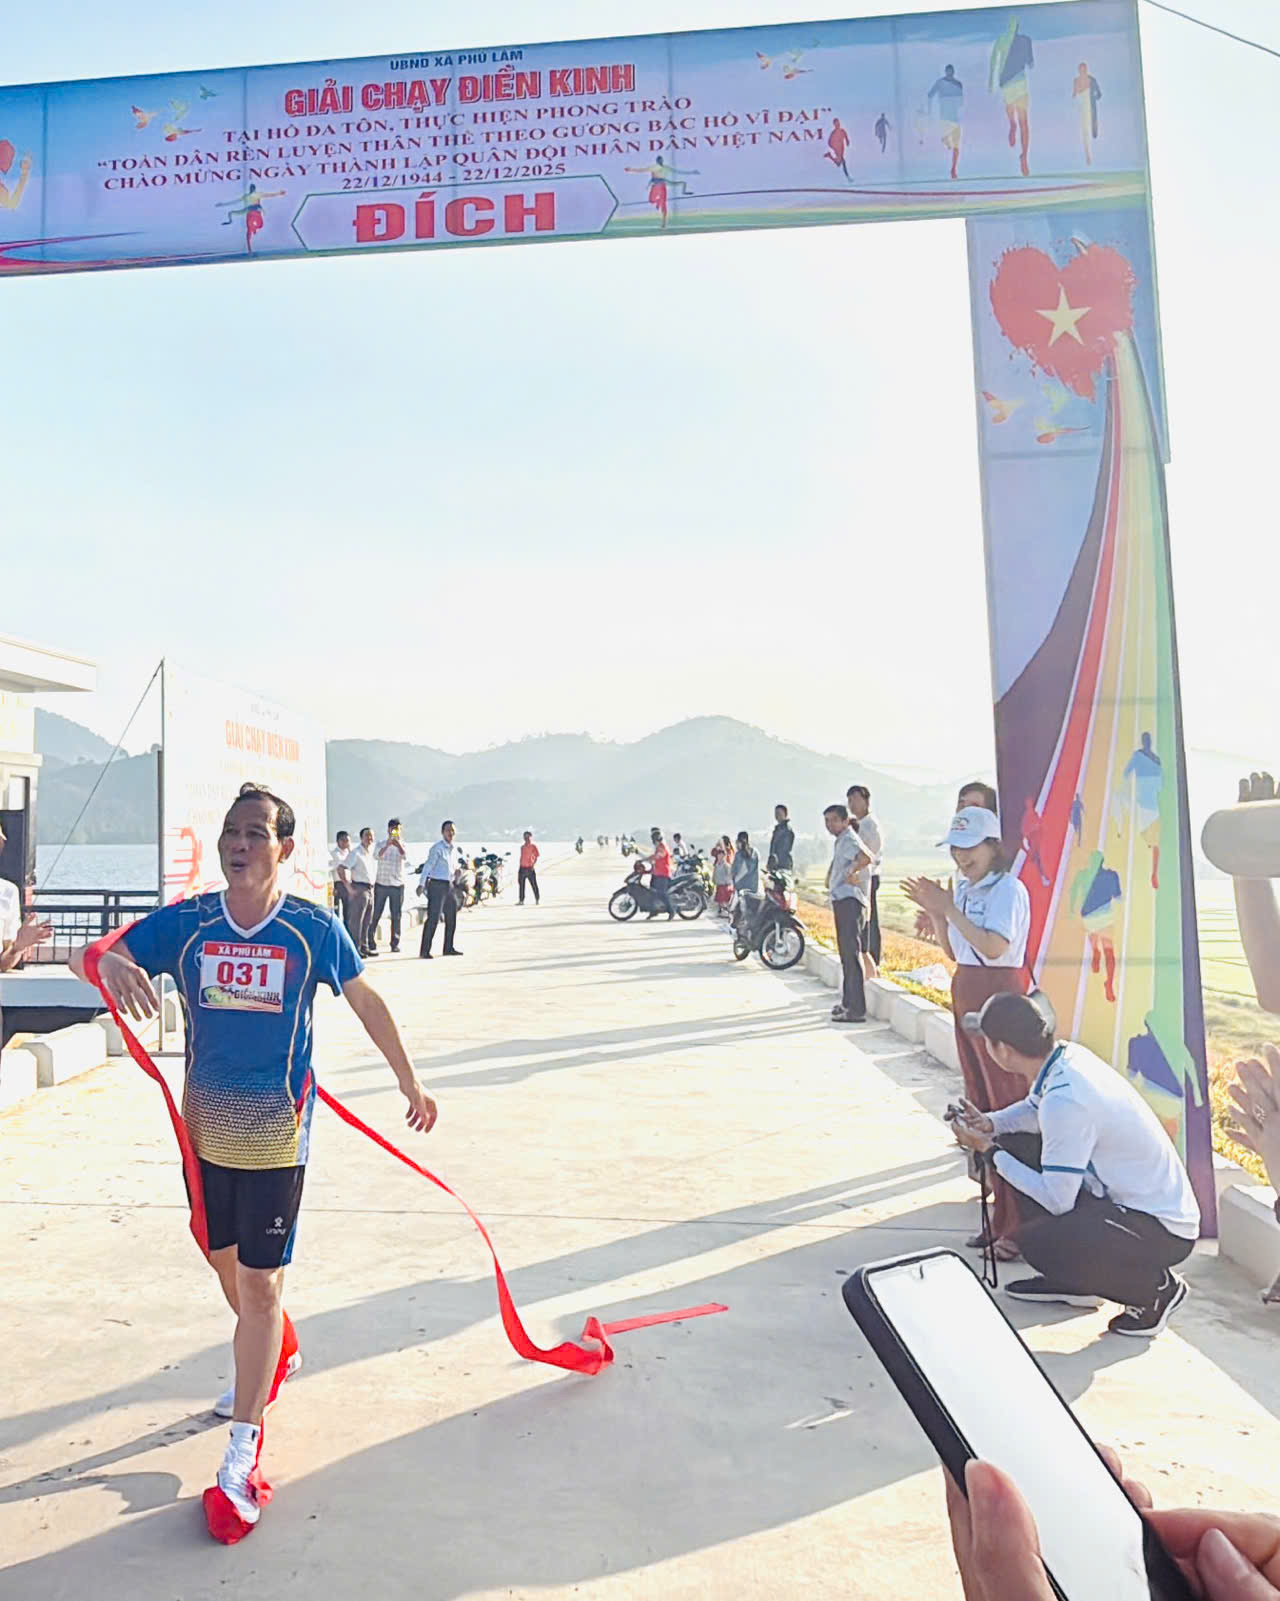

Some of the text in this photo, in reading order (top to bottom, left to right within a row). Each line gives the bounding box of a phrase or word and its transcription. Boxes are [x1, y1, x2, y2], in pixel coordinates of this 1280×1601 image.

[390, 58, 429, 70] UBND
[285, 64, 635, 117] GIẢI CHẠY ĐIỀN KINH
[175, 149, 219, 166] DÂN
[226, 146, 270, 162] RÈN
[278, 142, 352, 158] LUYỆN
[360, 134, 421, 152] THÂN
[481, 128, 546, 144] THEO
[552, 121, 640, 138] GƯƠNG
[648, 115, 696, 132] BÁC
[745, 109, 770, 125] VĨ
[223, 128, 259, 145] TẠI
[306, 124, 336, 137] ĐA
[341, 117, 394, 134] TÔN,
[400, 113, 465, 130] THỰC
[473, 108, 528, 125] HIỆN
[537, 102, 618, 119] PHONG
[625, 95, 692, 113] TRÀO
[104, 128, 823, 190] CHÀO MỪNG NGÀY THÀNH LẬP QUÂN ĐỘI NHÂN DÂN VIỆT NAM
[342, 172, 443, 190] 22/12/1944
[464, 163, 566, 181] 22/12/2025
[352, 191, 556, 243] ĐÍCH
[216, 960, 269, 987] 031
